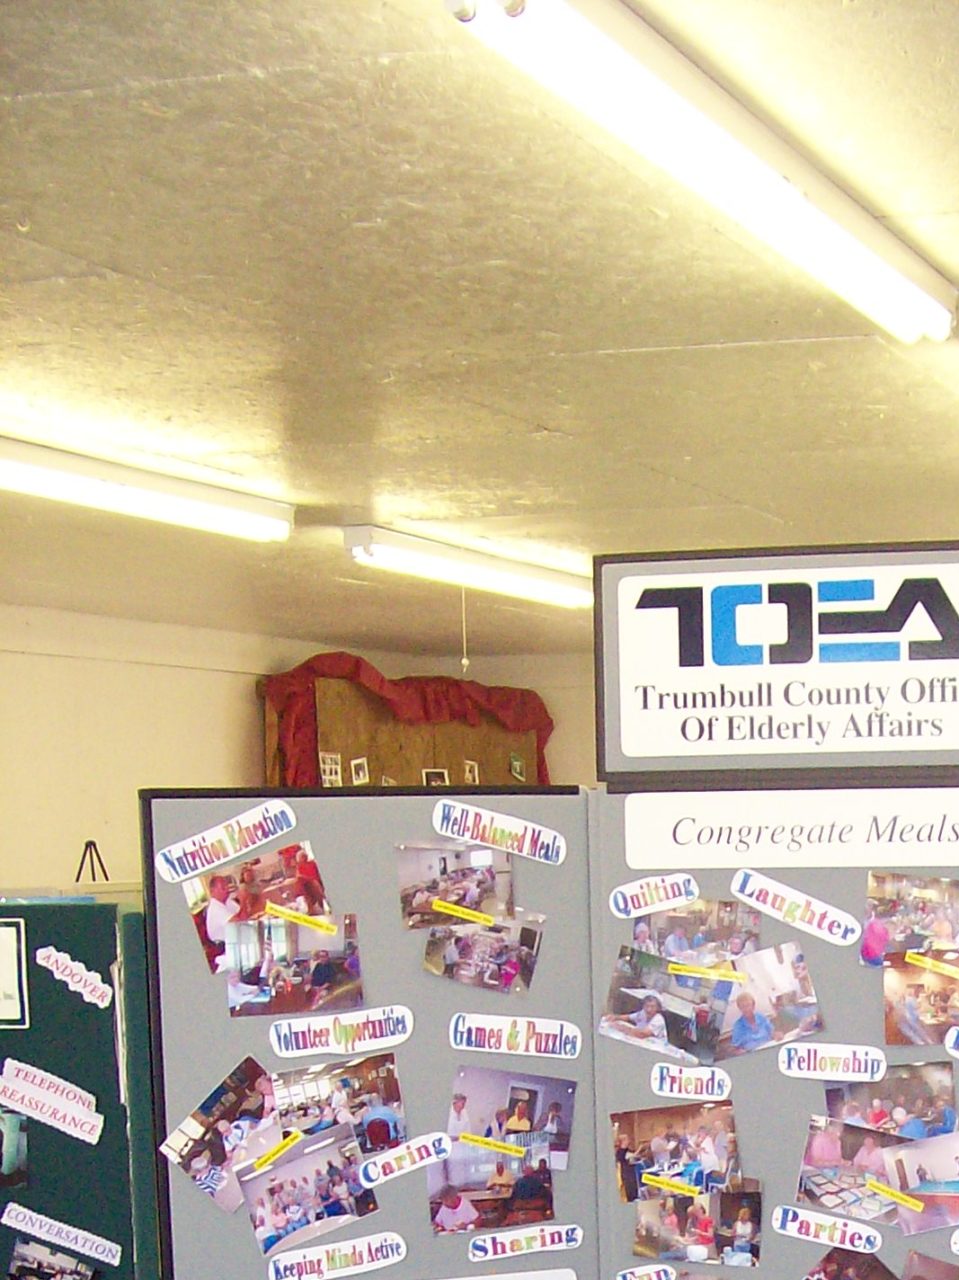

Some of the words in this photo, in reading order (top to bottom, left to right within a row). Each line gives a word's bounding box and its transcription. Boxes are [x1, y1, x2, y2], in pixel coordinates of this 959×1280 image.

[634, 682, 772, 713] Trumbull
[783, 678, 892, 717] County
[680, 714, 720, 744] Of
[726, 712, 832, 746] Elderly
[841, 710, 944, 739] Affairs
[161, 834, 230, 881] Nutrition
[225, 806, 293, 853] Education
[440, 803, 528, 854] Well-Balanced
[526, 827, 561, 864] Meals
[671, 815, 854, 853] Congregate
[611, 874, 696, 917] Quilting
[738, 871, 857, 945] Laughter
[41, 953, 107, 1003] ANDOVER
[273, 1020, 330, 1053] Volunteer
[333, 1008, 408, 1052] Opportunities
[454, 1013, 502, 1049] Games
[524, 1018, 578, 1056] Puzzles
[657, 1067, 725, 1096] Friends
[784, 1047, 883, 1081] Fellowship
[0, 1086, 98, 1137] REASSURANCE
[14, 1066, 95, 1112] TELEPHONE
[362, 1133, 445, 1184] Caring
[6, 1207, 119, 1262] CONVERSATION
[471, 1224, 579, 1258] Sharing
[778, 1206, 878, 1252] Parties
[325, 1246, 365, 1271] Minds
[367, 1238, 403, 1265] Active
